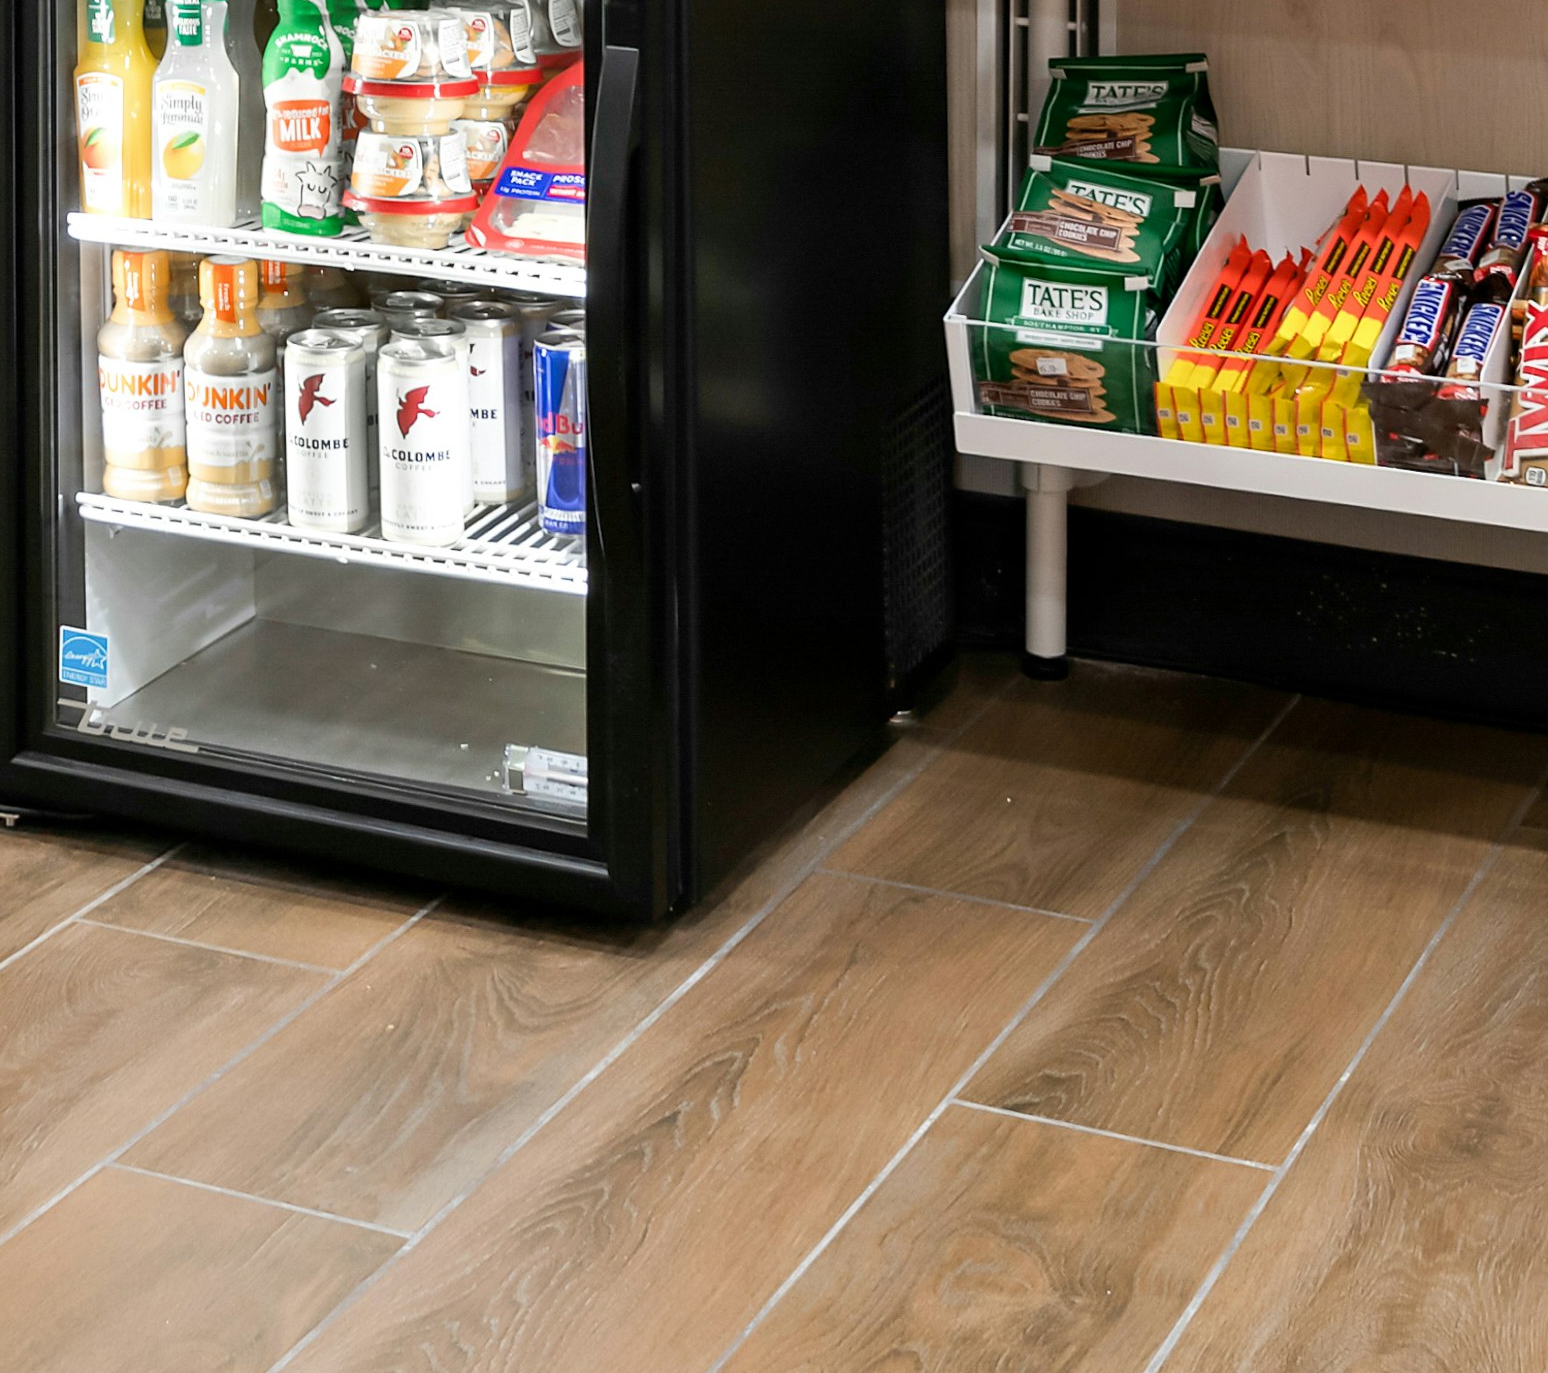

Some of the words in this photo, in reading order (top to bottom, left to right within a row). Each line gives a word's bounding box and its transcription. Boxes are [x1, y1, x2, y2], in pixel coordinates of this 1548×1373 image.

[275, 33, 328, 51] SHAMROCK
[1091, 85, 1165, 101] TATE'S
[161, 95, 203, 113] Simply
[279, 119, 321, 142] MILK
[1116, 139, 1133, 150] CHIP
[1058, 230, 1087, 242] COOKIES
[1060, 221, 1098, 235] CHOCOLATE
[1099, 227, 1117, 238] CHIP
[1028, 283, 1104, 311] TATE'S
[1034, 308, 1062, 320] BAKE
[1065, 310, 1094, 320] SHOP
[1454, 303, 1504, 364] SNICKERS
[1030, 389, 1067, 401] CHOCOLATE
[1069, 392, 1086, 402] CHIP
[1032, 397, 1062, 407] COOKIES
[214, 410, 260, 424] COFFEE
[294, 437, 351, 450] COLOMBE
[391, 449, 451, 462] COLOMBE
